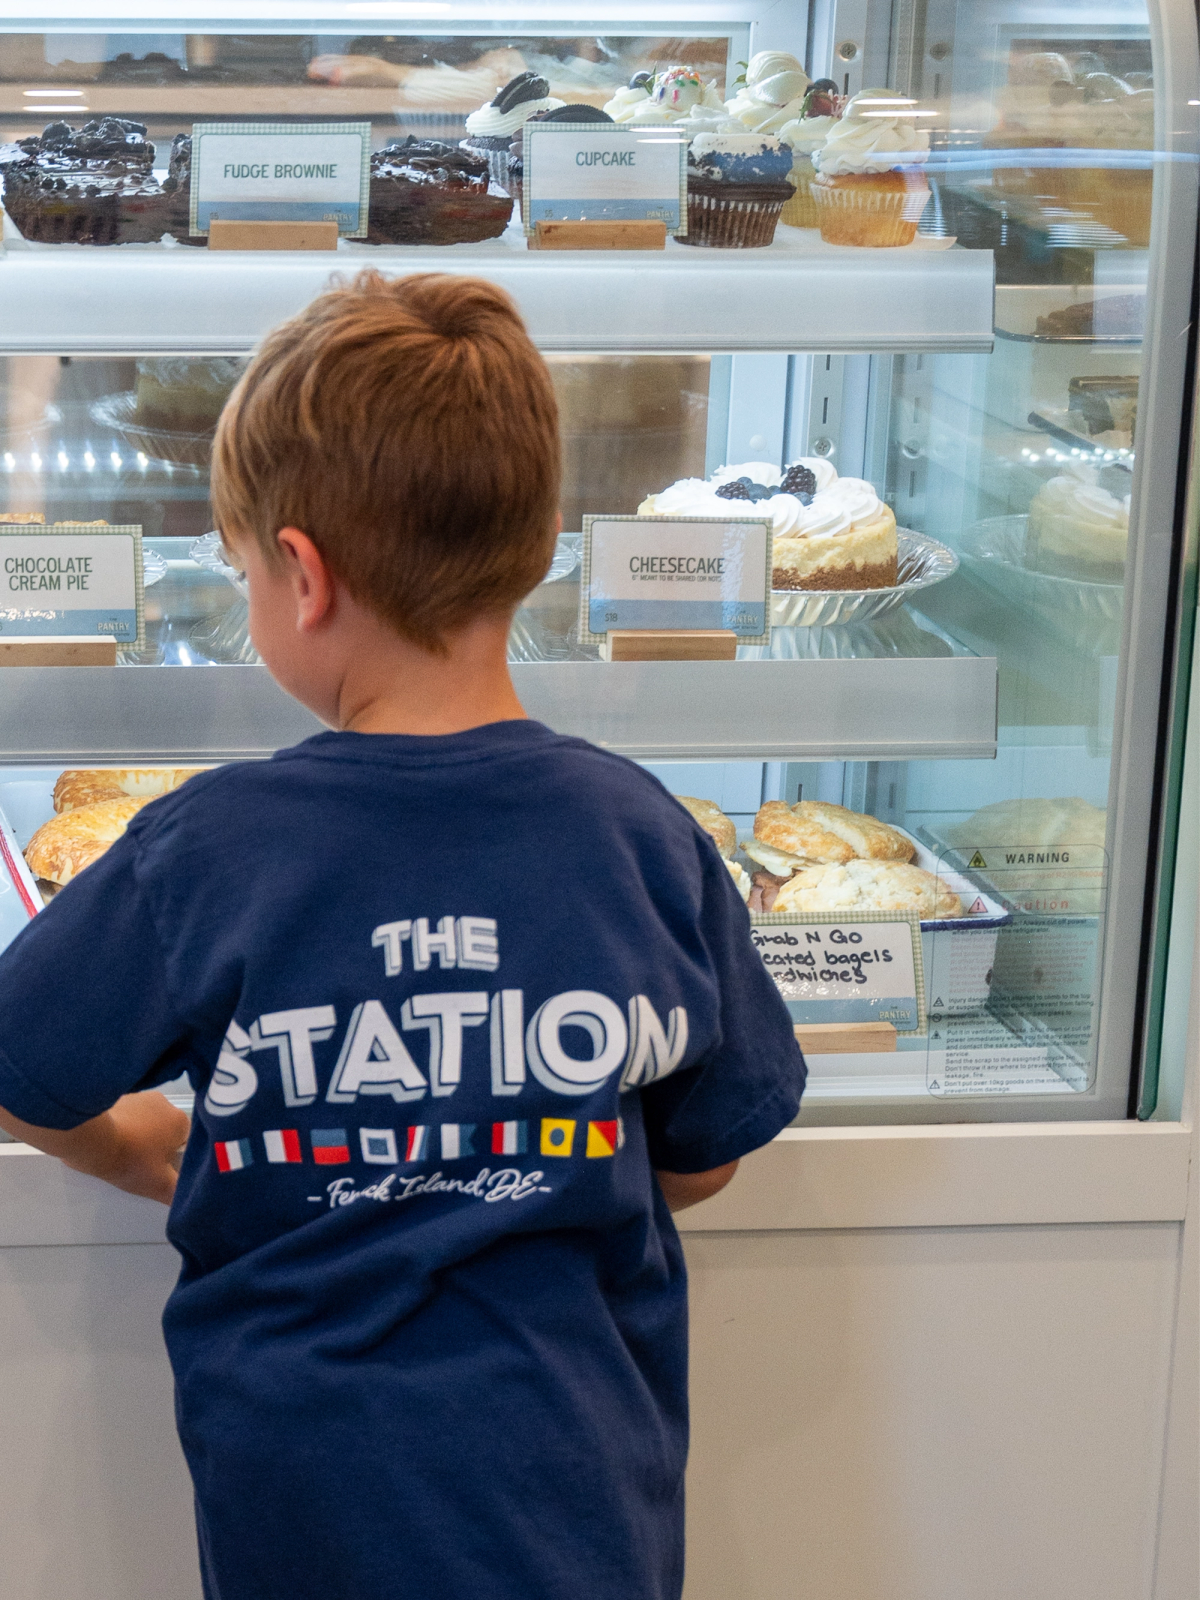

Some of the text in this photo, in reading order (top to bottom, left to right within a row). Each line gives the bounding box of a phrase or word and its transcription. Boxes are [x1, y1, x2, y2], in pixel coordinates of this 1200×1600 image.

[575, 151, 636, 167] CUPCAKE
[223, 163, 338, 179] FUDGE BROWNIE
[322, 213, 353, 222] PANTRY
[646, 210, 674, 219] PANTRY
[4, 557, 93, 574] CHOCOLATE
[629, 556, 726, 574] CHEESECAKE
[8, 574, 89, 591] CREAM PIE
[98, 622, 130, 633] PANTRY
[727, 615, 758, 625] PANTRY
[1005, 852, 1070, 864] WARNING
[1002, 899, 1069, 911] Caution
[805, 931, 821, 944] N
[829, 929, 863, 944] Go
[371, 915, 499, 977] THE
[762, 949, 893, 970] eated bagels
[879, 1010, 911, 1022] PANTRY
[203, 988, 689, 1117] STATION
